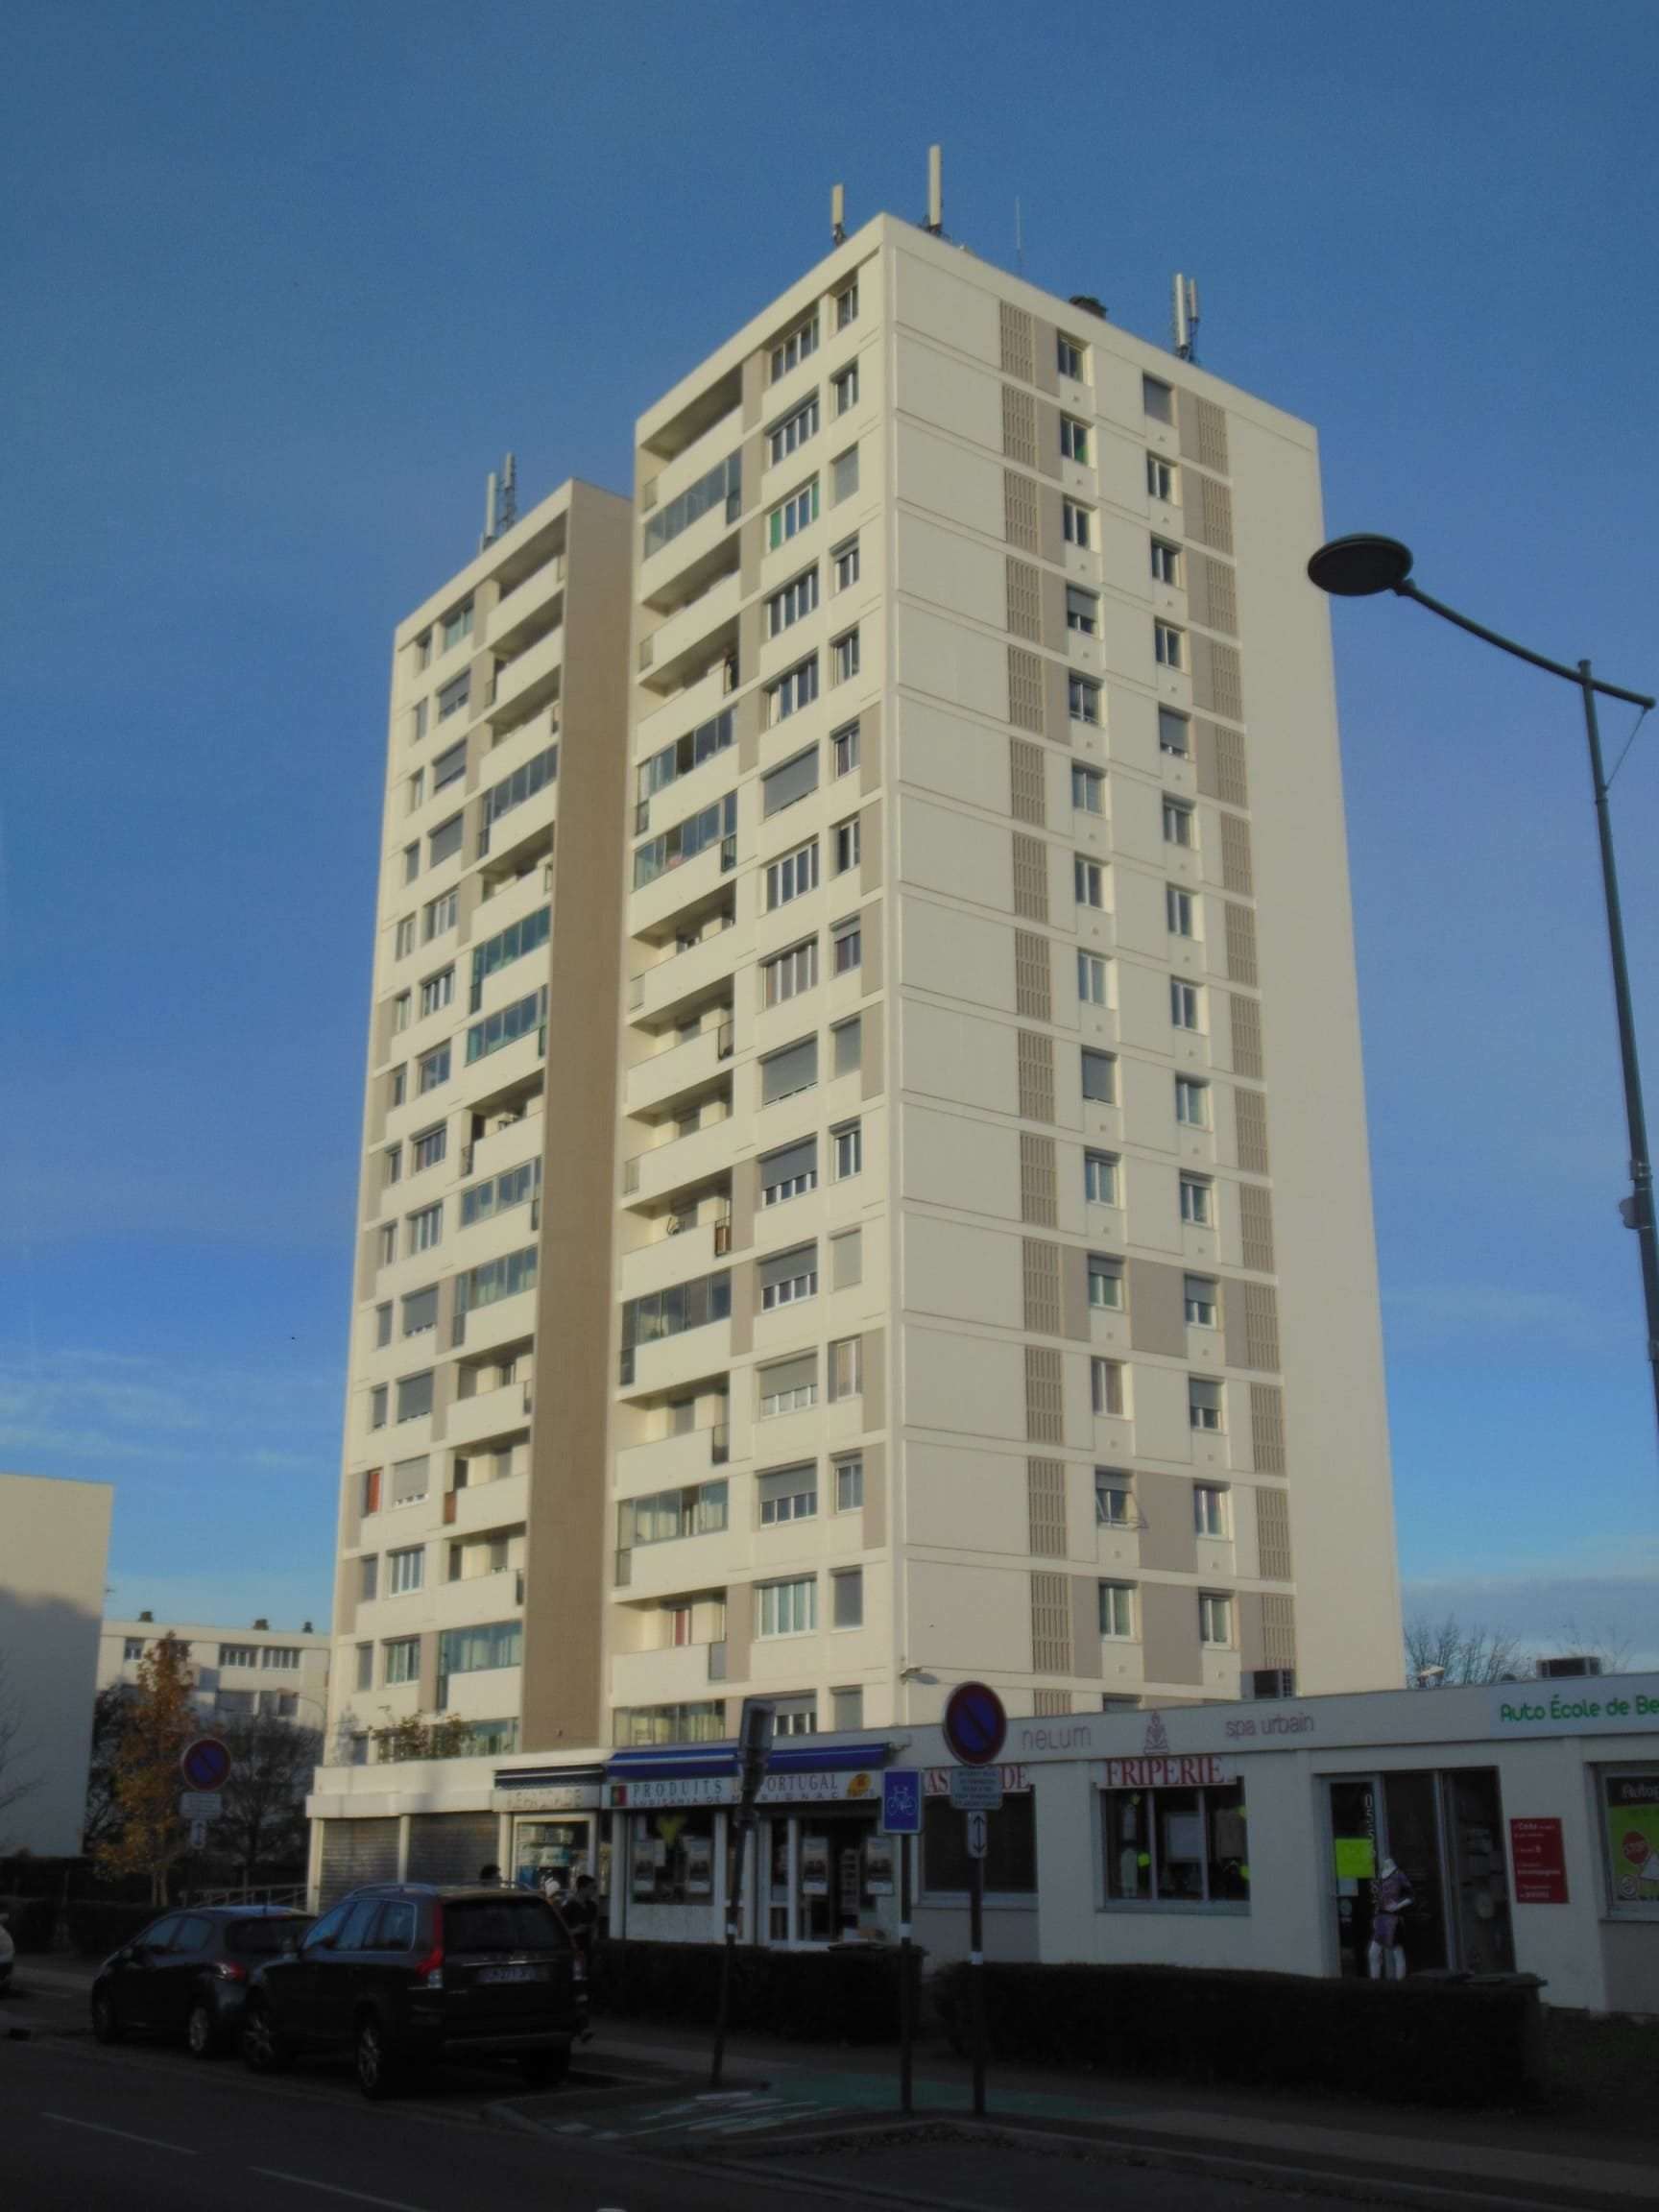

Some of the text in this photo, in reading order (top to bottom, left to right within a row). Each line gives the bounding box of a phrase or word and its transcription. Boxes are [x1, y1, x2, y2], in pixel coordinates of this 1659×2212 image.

[1500, 1703, 1546, 1721] Auto
[1551, 1694, 1599, 1719] École
[1605, 1698, 1629, 1717] de
[1225, 1713, 1314, 1741] spa urbain
[1105, 1756, 1224, 1787] FRIPERIE
[633, 1779, 723, 1798] PRODUITS
[766, 1773, 838, 1792] ORTUGAL
[731, 1791, 839, 1802] MRIGNAC
